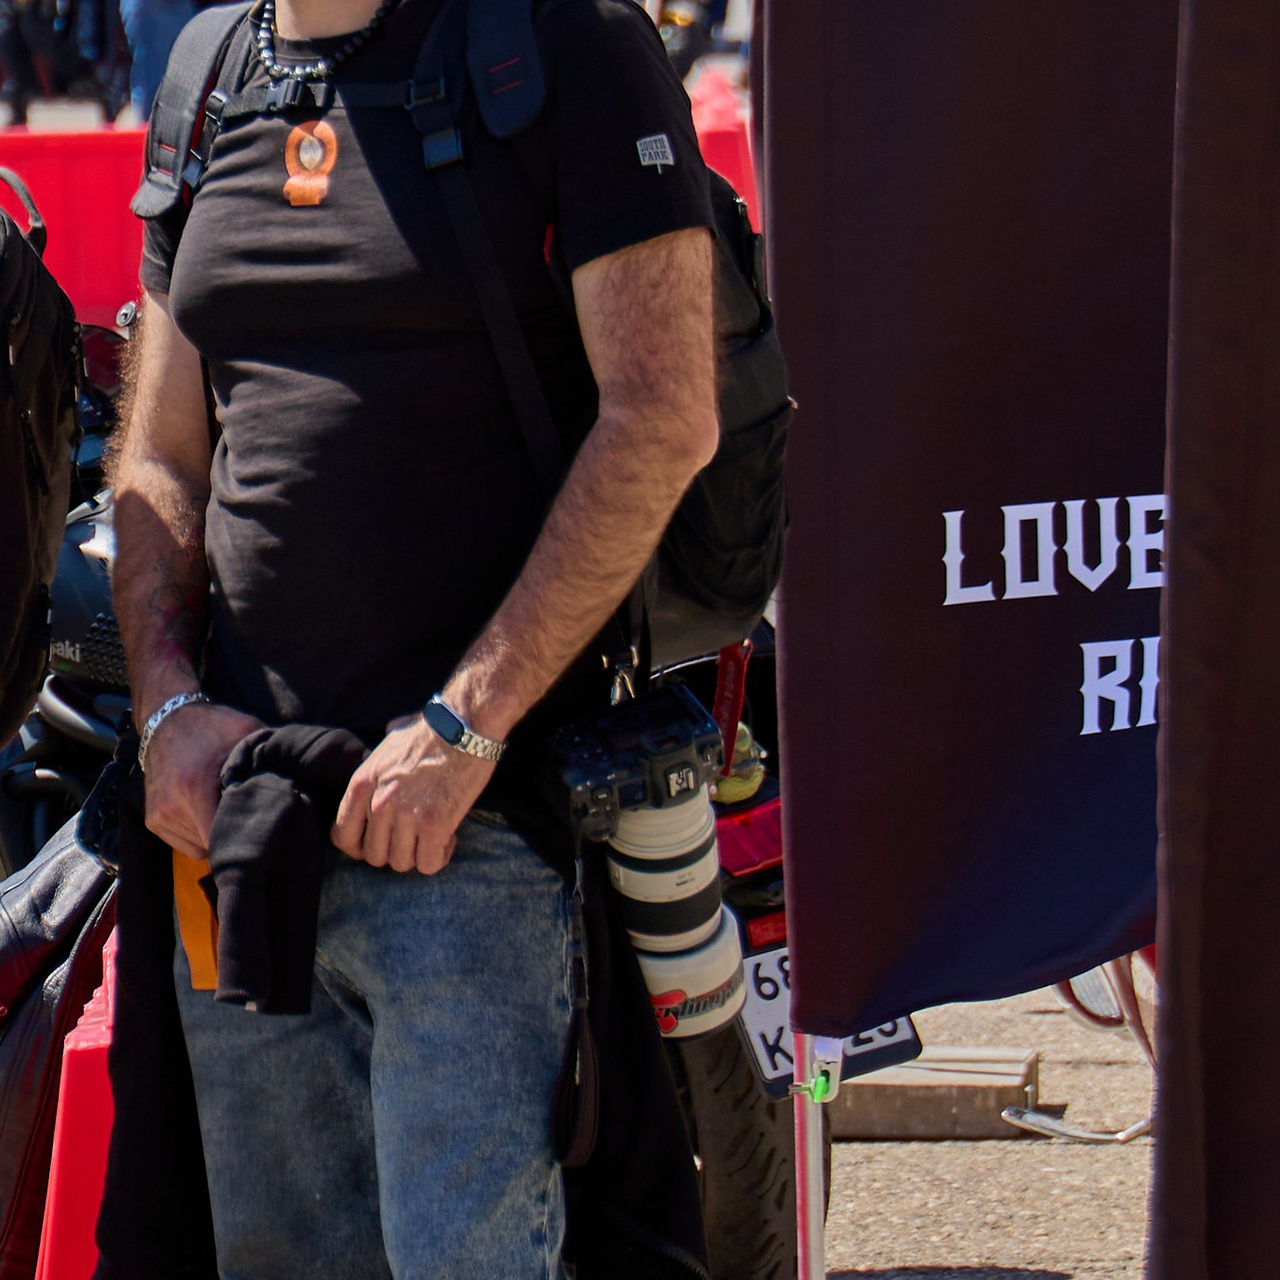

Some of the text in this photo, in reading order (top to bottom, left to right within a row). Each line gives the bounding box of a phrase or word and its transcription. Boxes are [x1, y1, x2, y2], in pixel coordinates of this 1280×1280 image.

[639, 137, 666, 152] SOUTH
[641, 150, 669, 162] PARK
[942, 494, 1167, 606] LOVE
